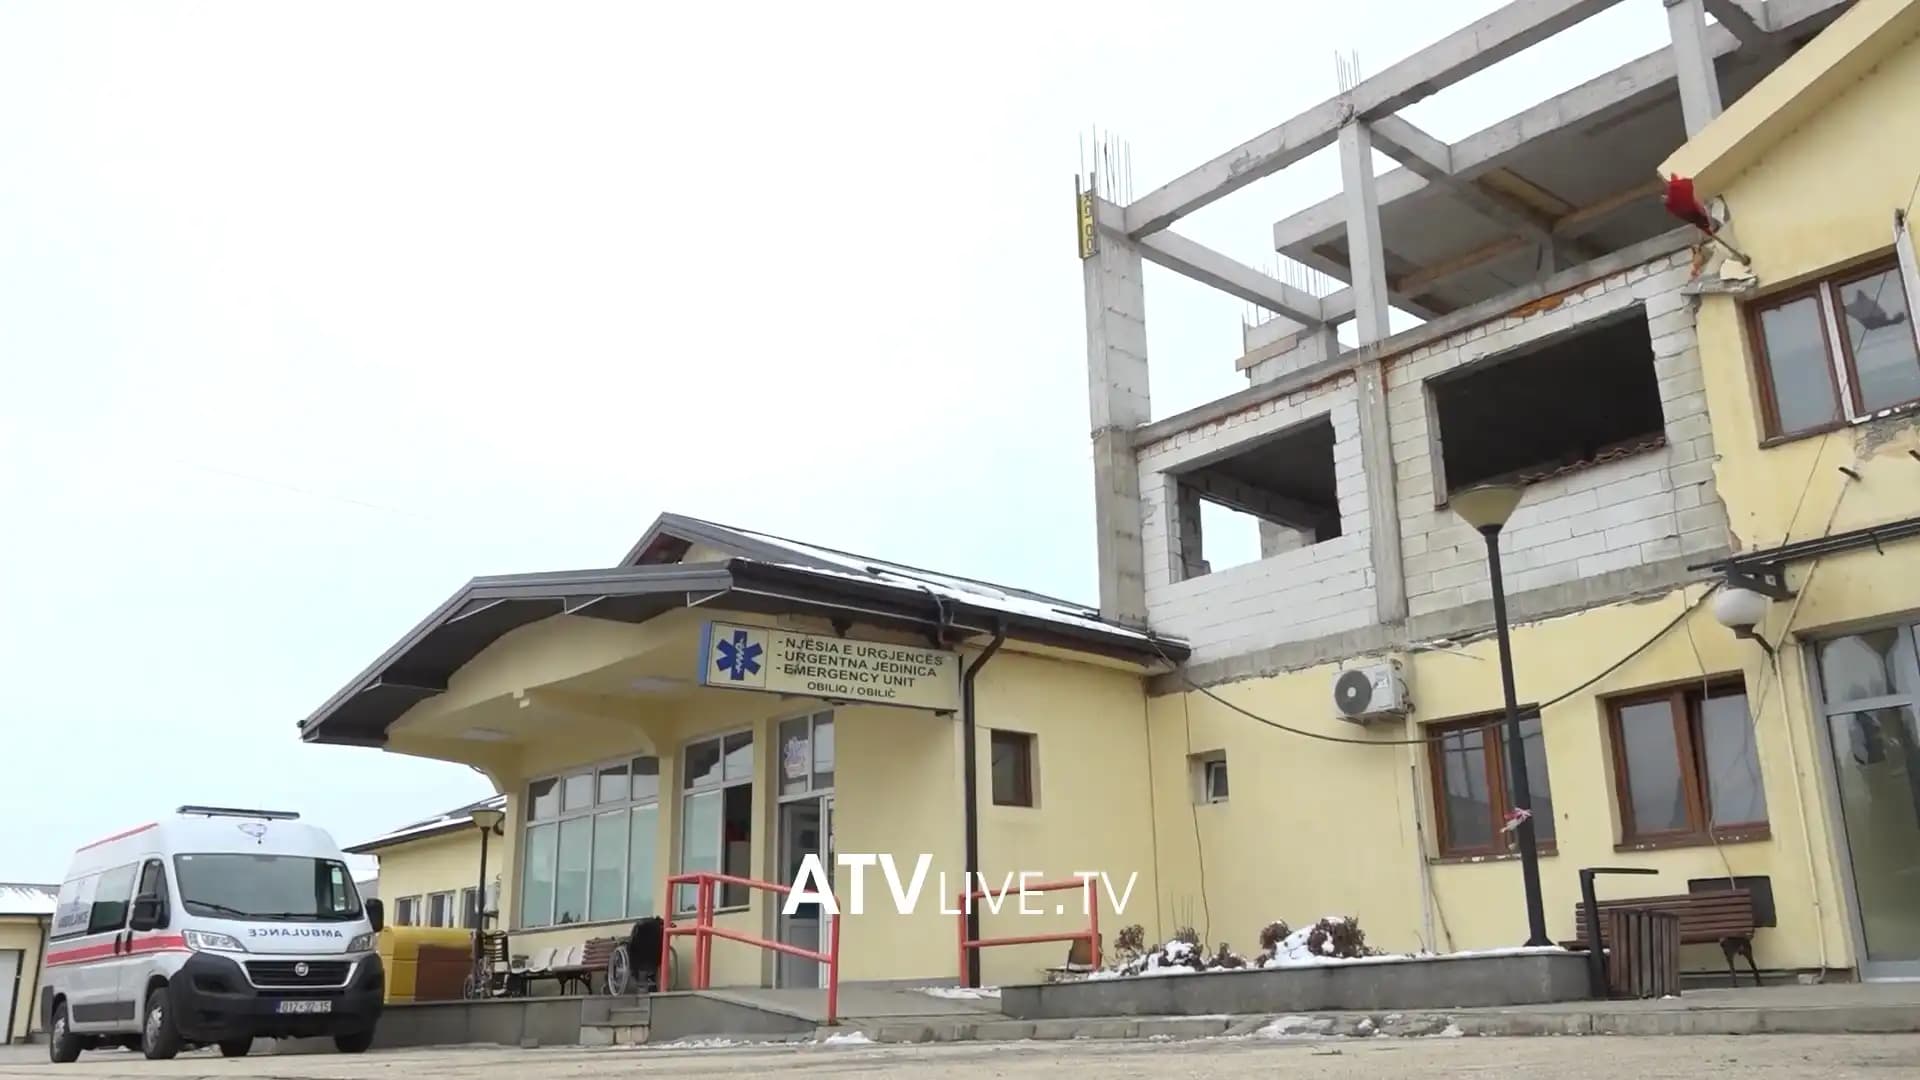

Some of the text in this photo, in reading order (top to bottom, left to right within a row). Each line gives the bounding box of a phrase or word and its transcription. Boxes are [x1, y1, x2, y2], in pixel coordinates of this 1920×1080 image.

[785, 637, 839, 653] NJËSIA
[843, 644, 853, 655] E
[785, 651, 868, 669] URGENTNA
[871, 662, 937, 677] JEDINICA
[784, 663, 879, 683] EMERGENCY
[883, 676, 915, 687] UNIT
[807, 681, 848, 694] OBILIQ
